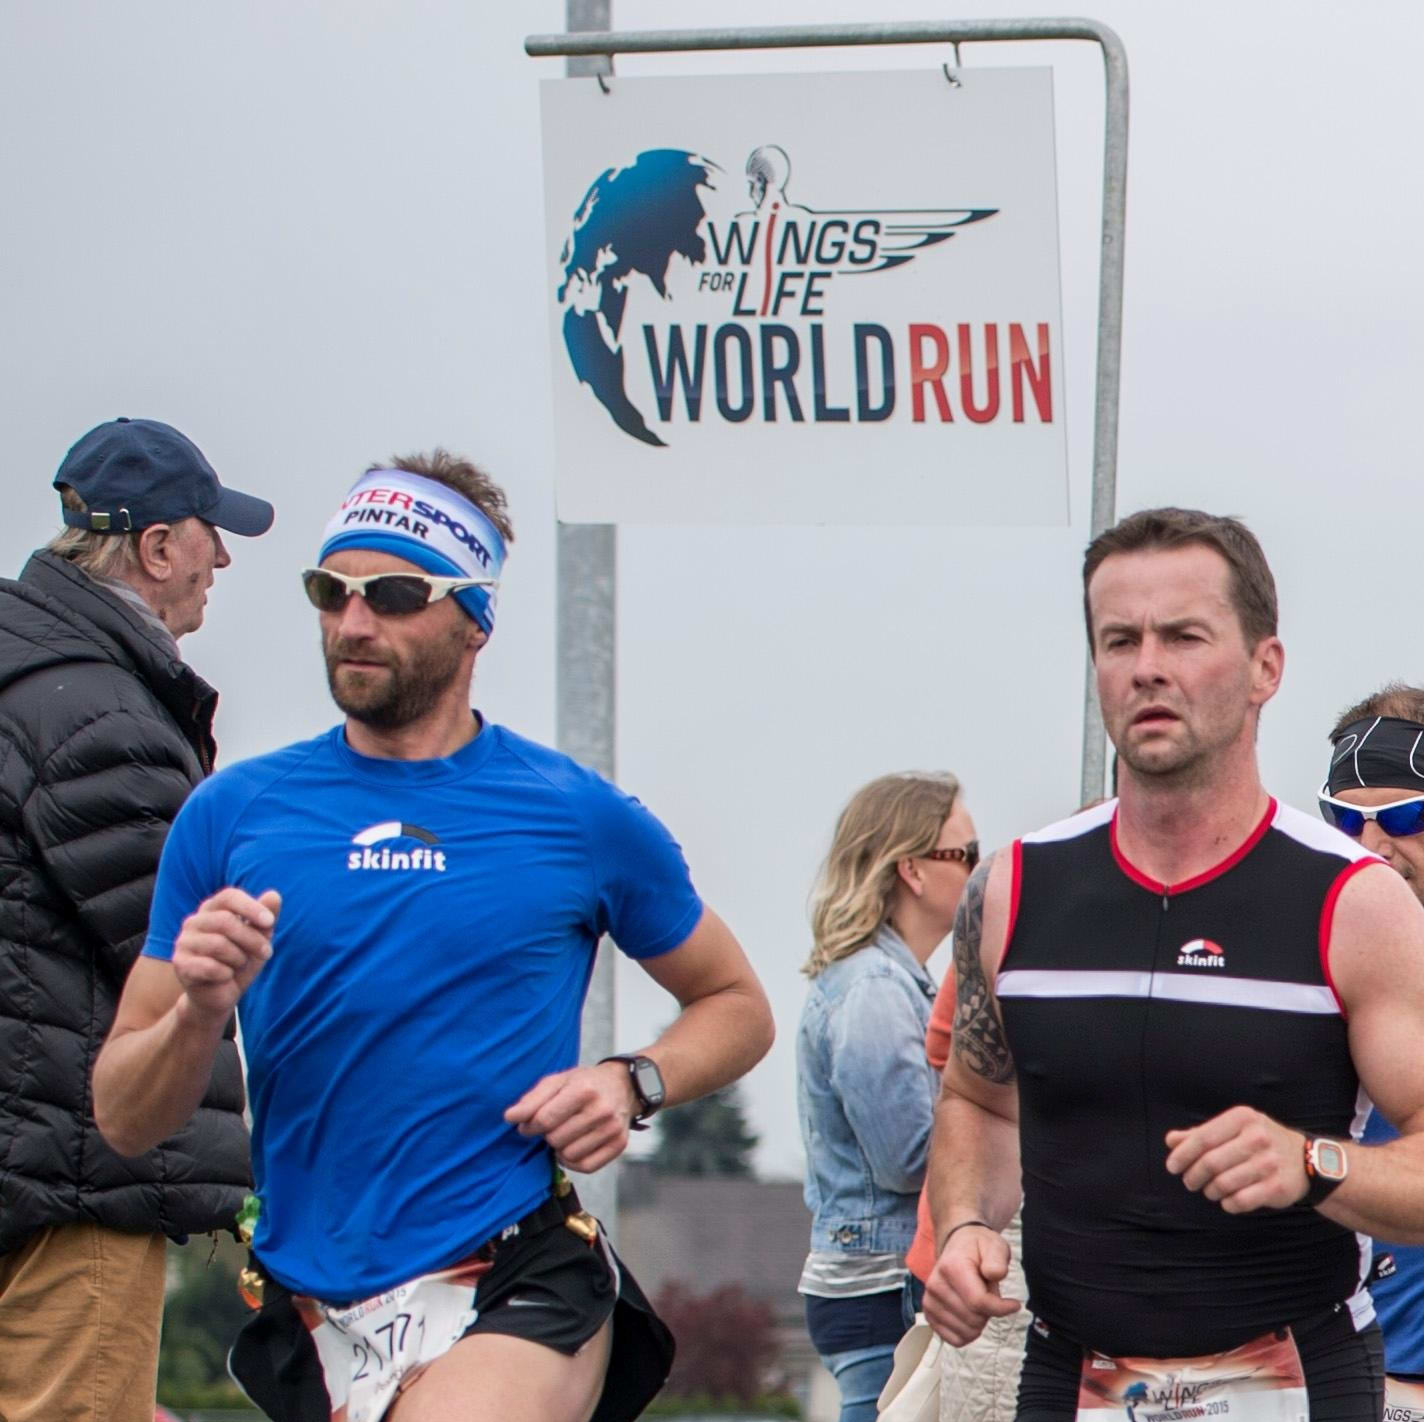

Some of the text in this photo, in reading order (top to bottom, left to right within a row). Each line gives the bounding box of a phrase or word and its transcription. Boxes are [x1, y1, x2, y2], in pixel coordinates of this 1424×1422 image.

[707, 210, 881, 266] WINGS
[699, 270, 833, 317] FOR LIFE
[642, 322, 1054, 424] WORLD RUN
[343, 507, 430, 540] PINTAR
[347, 848, 447, 872] skinfit
[1177, 954, 1225, 968] skinfit
[1206, 1400, 1230, 1416] 2015
[1384, 1408, 1412, 1422] NGS
